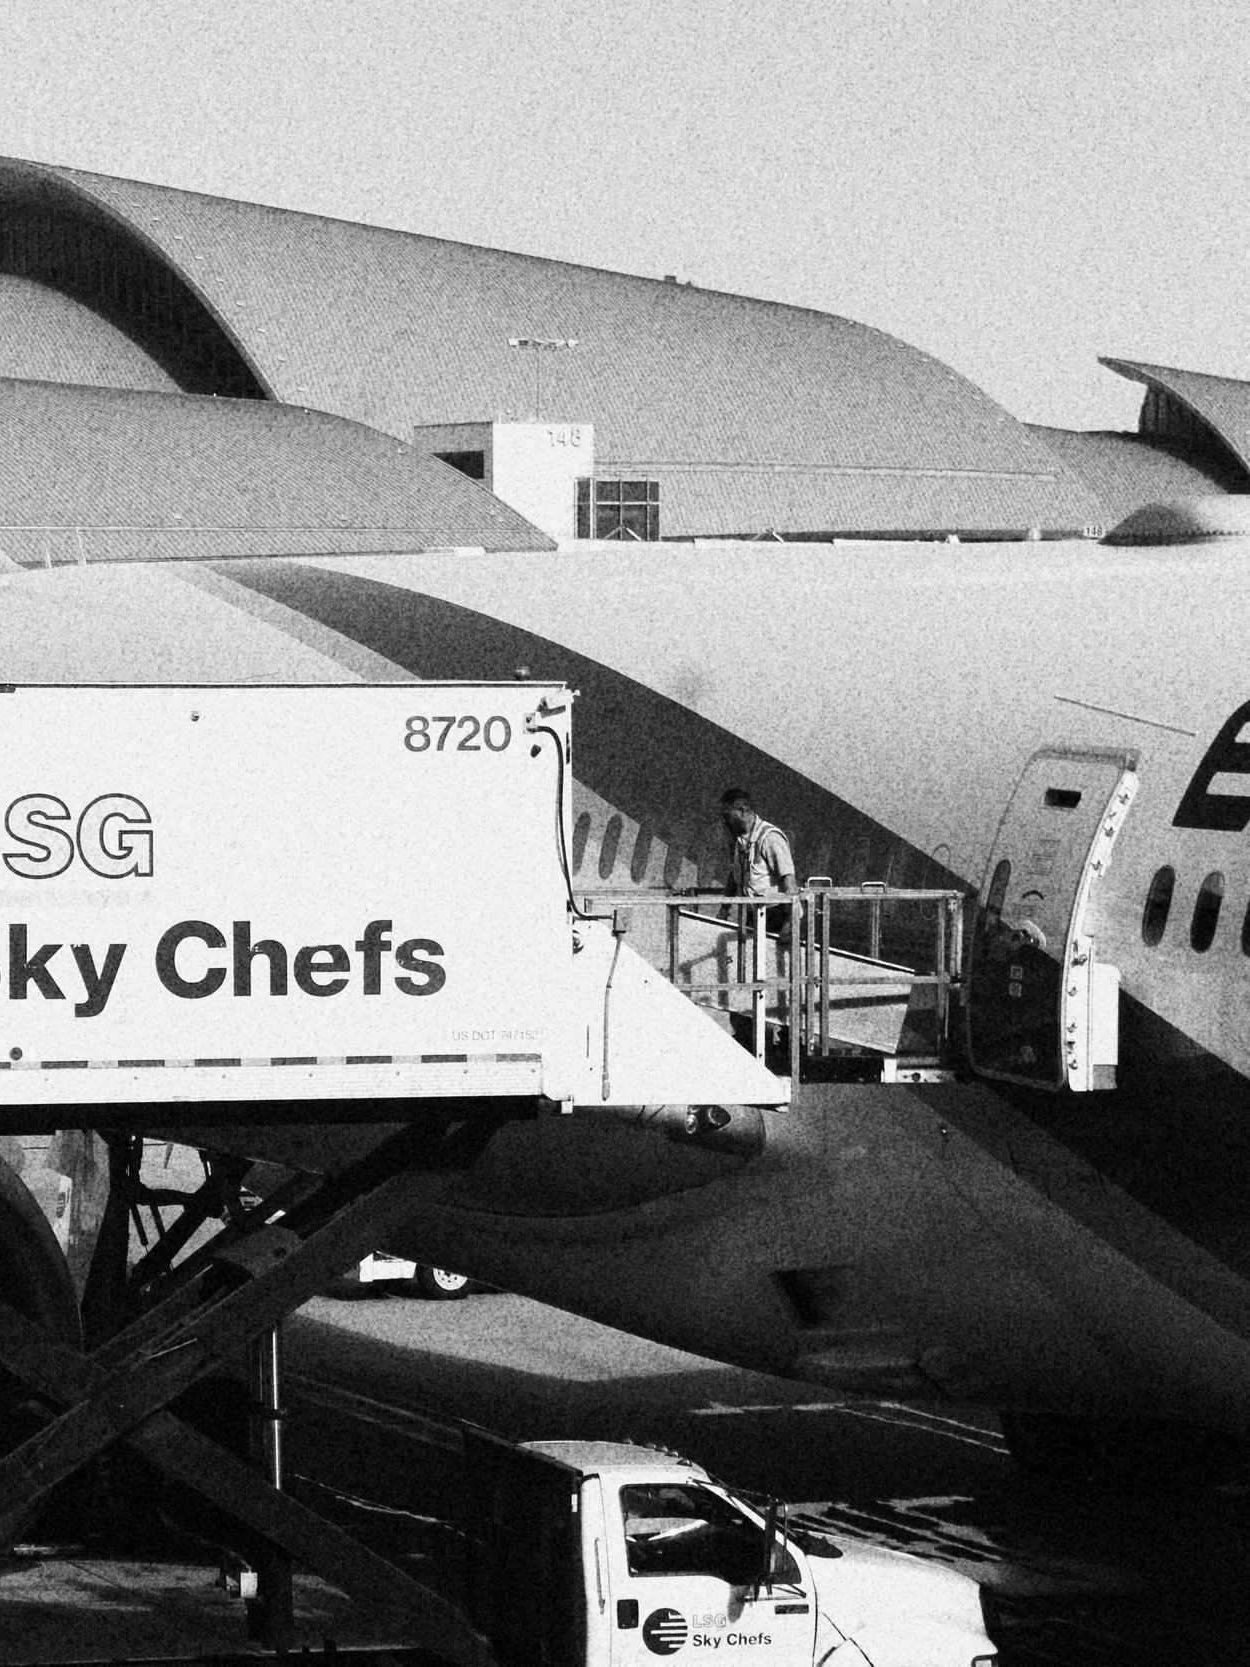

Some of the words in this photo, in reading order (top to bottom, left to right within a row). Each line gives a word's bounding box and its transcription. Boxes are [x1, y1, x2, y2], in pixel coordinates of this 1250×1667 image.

[547, 426, 581, 447] 148
[403, 715, 512, 752] 8720
[155, 919, 447, 999] Chefs
[452, 1030, 469, 1041] US
[472, 1030, 496, 1041] DOT
[692, 1613, 727, 1629] LSG
[692, 1634, 722, 1649] Sky
[726, 1632, 772, 1646] Chefs
